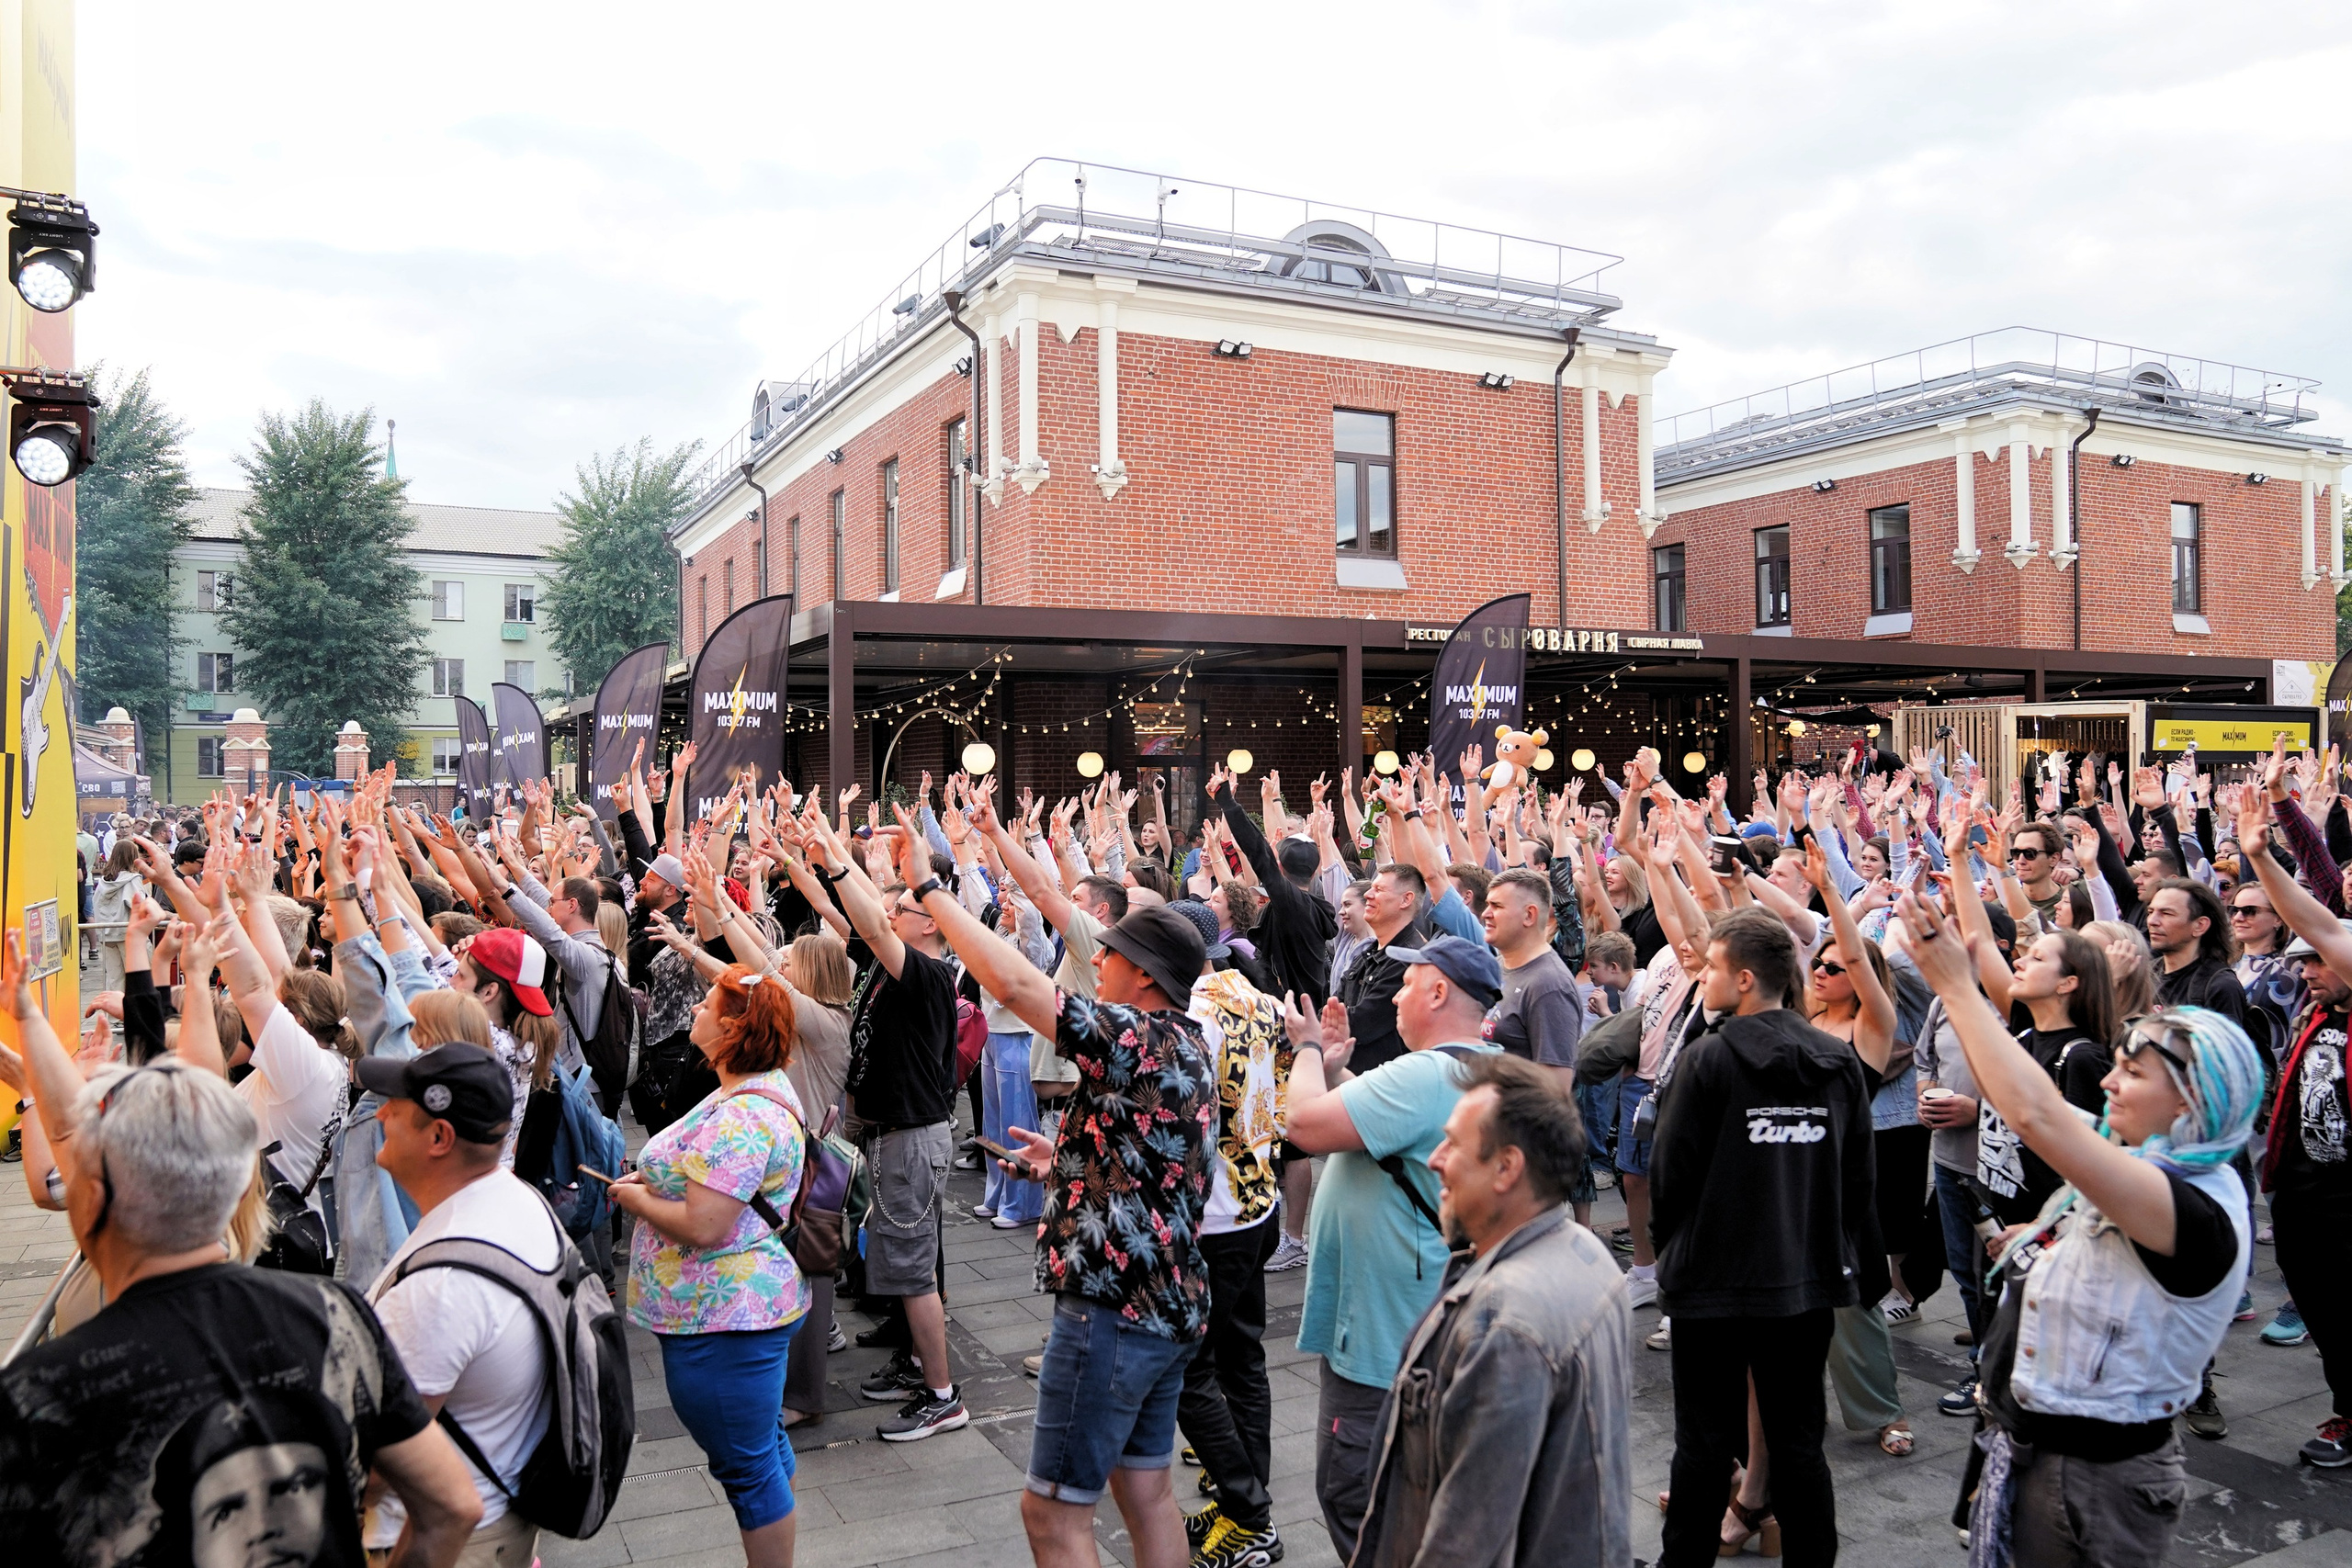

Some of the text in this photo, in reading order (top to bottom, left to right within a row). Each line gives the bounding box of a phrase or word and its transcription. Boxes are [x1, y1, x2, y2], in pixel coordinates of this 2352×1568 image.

[1482, 626, 1620, 653] СЫРОВАРНЯ
[1627, 637, 1669, 649] СЫРНАЯ
[1670, 638, 1704, 650] ЛАВКА
[1445, 685, 1518, 705] MAXIMUM
[704, 691, 777, 714] MAXIMUM
[1487, 708, 1499, 719] FM
[600, 714, 653, 731] MAXIMUM
[746, 716, 761, 728] FM
[2222, 731, 2247, 743] MAXIMUM
[1746, 1106, 1828, 1118] PORSCHE
